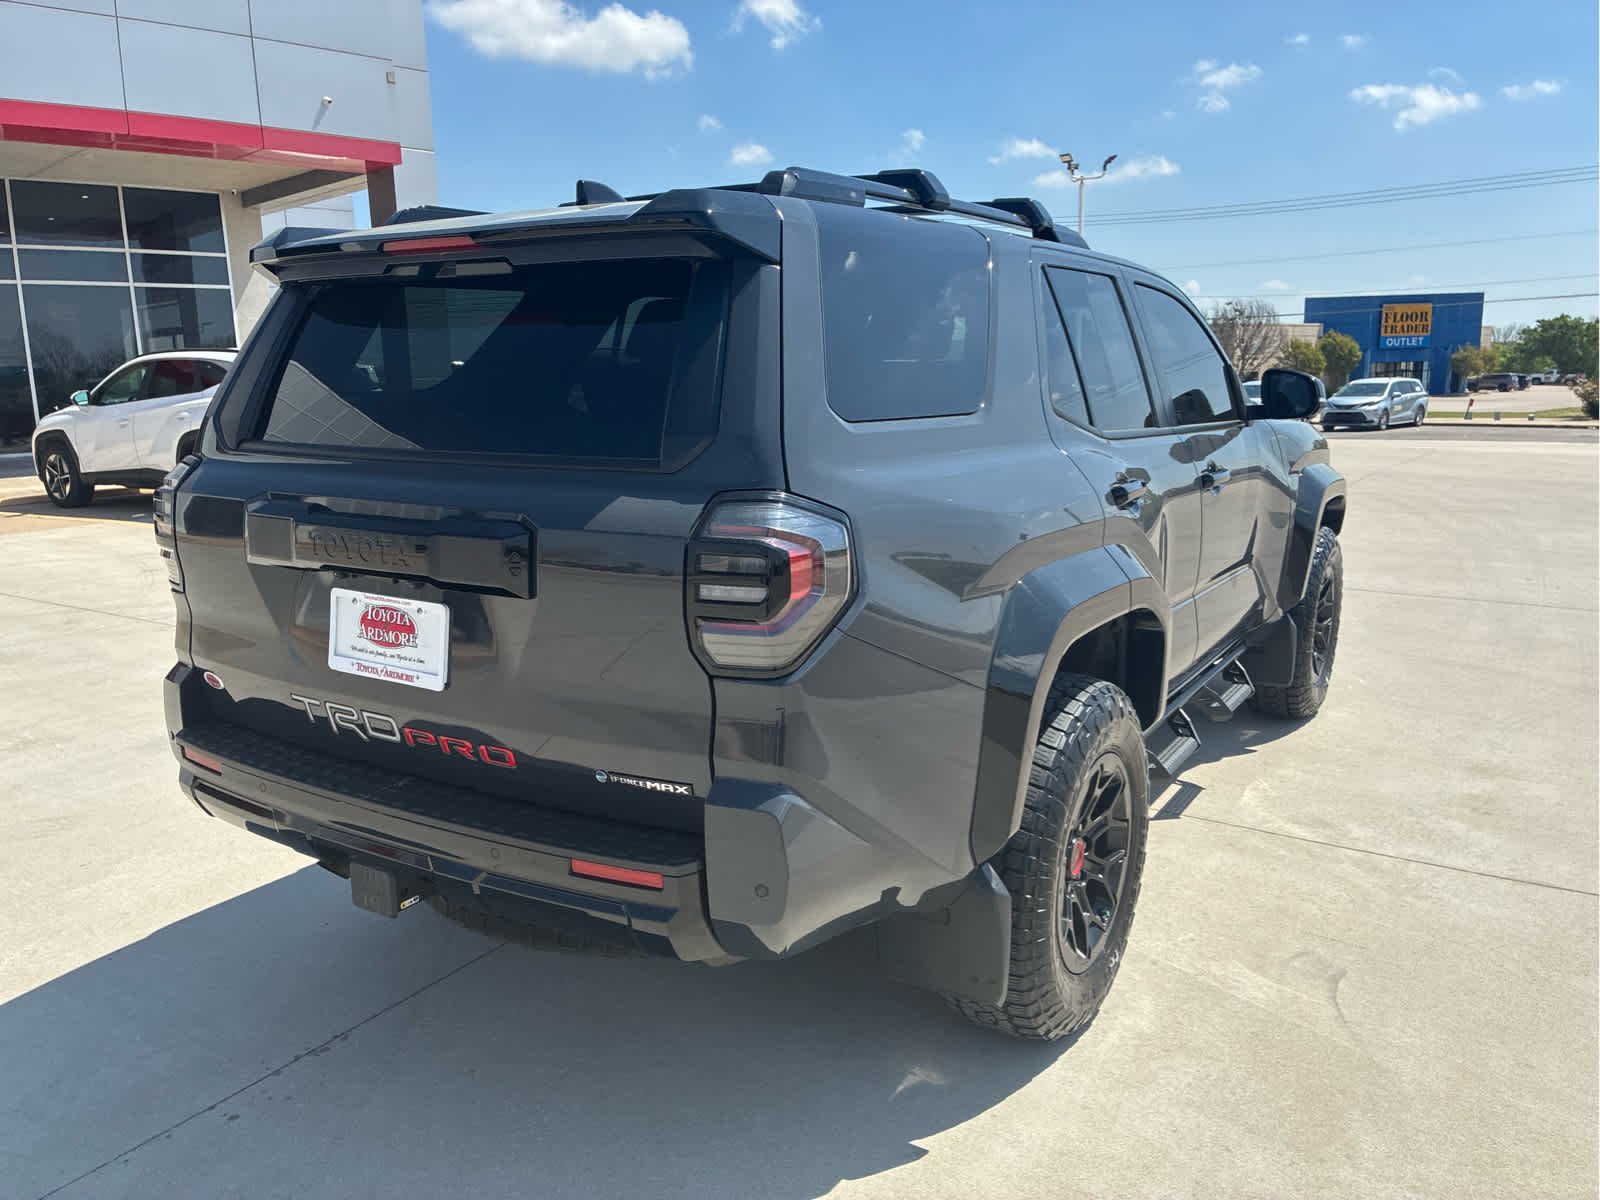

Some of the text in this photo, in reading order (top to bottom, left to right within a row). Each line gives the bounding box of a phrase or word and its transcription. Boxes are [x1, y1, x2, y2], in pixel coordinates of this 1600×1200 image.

[1384, 311, 1429, 323] FLOOR
[1383, 323, 1429, 334] TRADER
[1386, 336, 1424, 346] OUTLET
[307, 529, 415, 567] TOYOTA
[367, 604, 411, 626] TOYOTA
[358, 623, 418, 648] ARDMORE
[355, 662, 379, 676] TOYOTA
[384, 668, 415, 683] ARDMORE
[290, 693, 517, 769] TRD PRO
[646, 780, 689, 795] MAX
